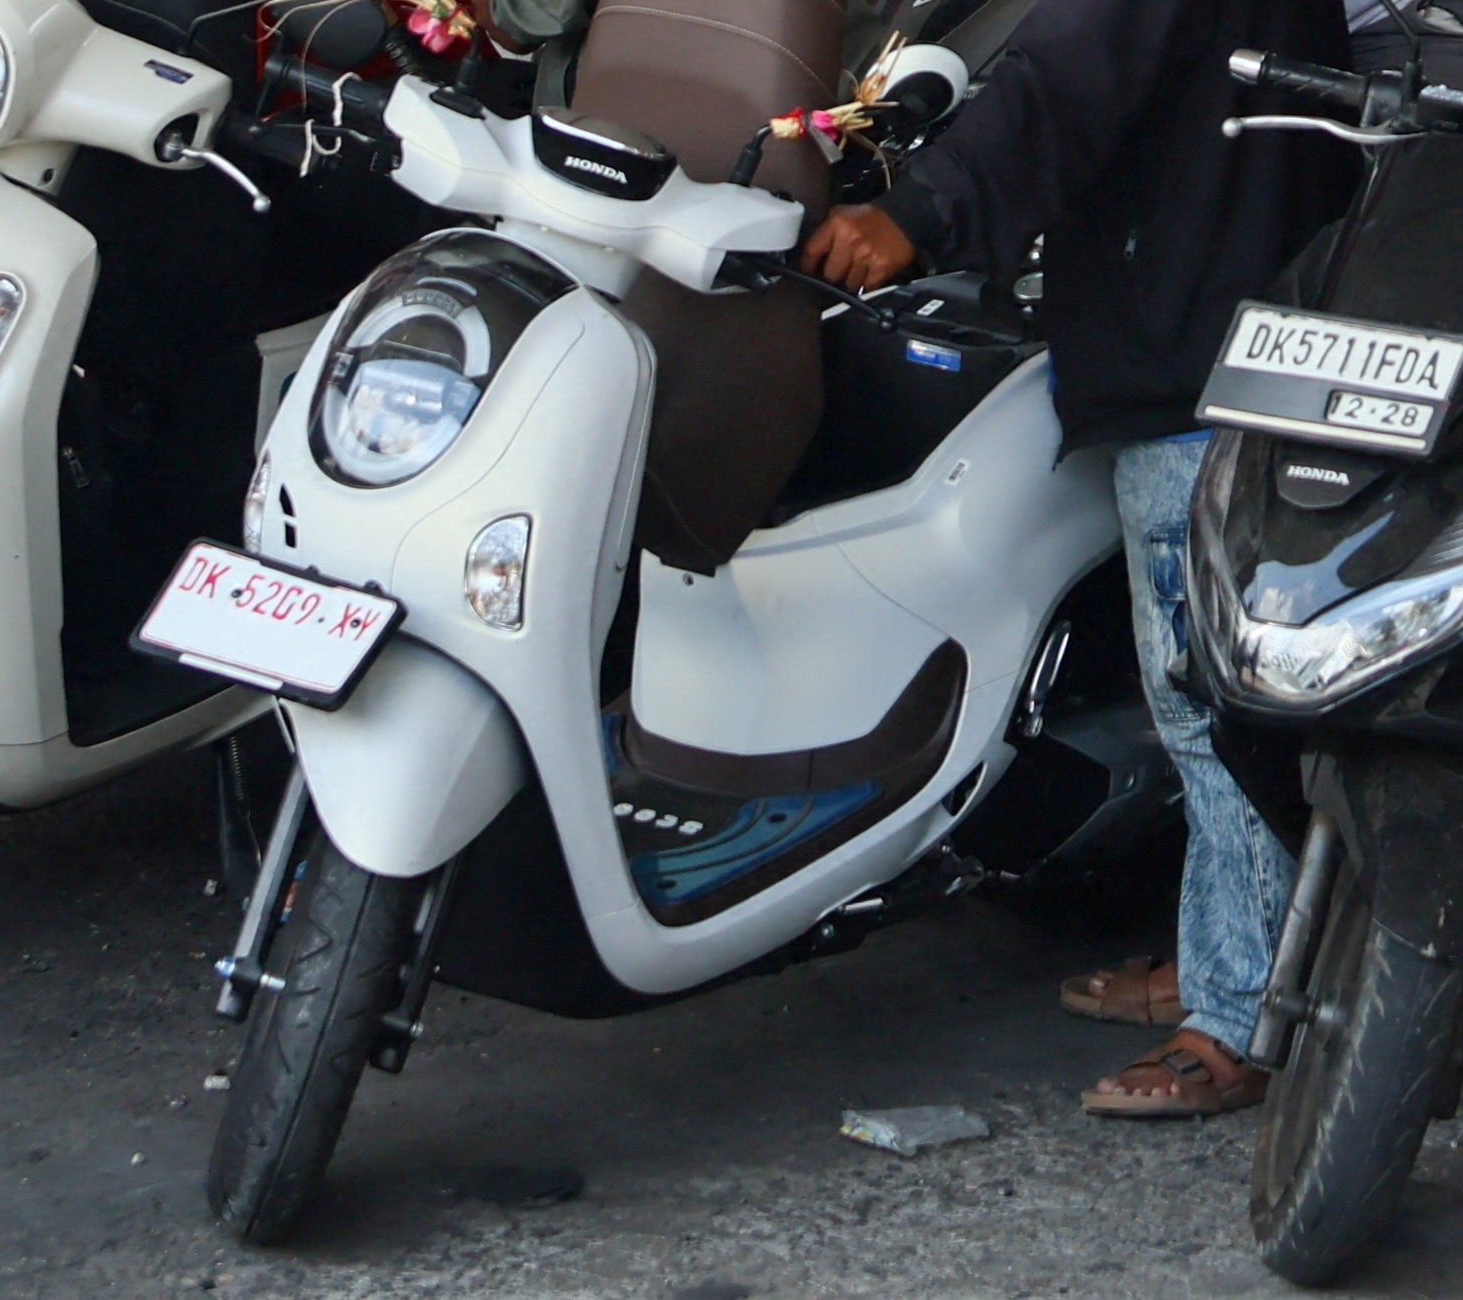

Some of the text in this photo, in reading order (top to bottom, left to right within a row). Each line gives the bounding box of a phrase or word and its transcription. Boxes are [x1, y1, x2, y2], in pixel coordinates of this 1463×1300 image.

[1245, 325, 1442, 389] DK5711FDA
[1287, 465, 1350, 486] HONDA
[178, 555, 233, 599] DK
